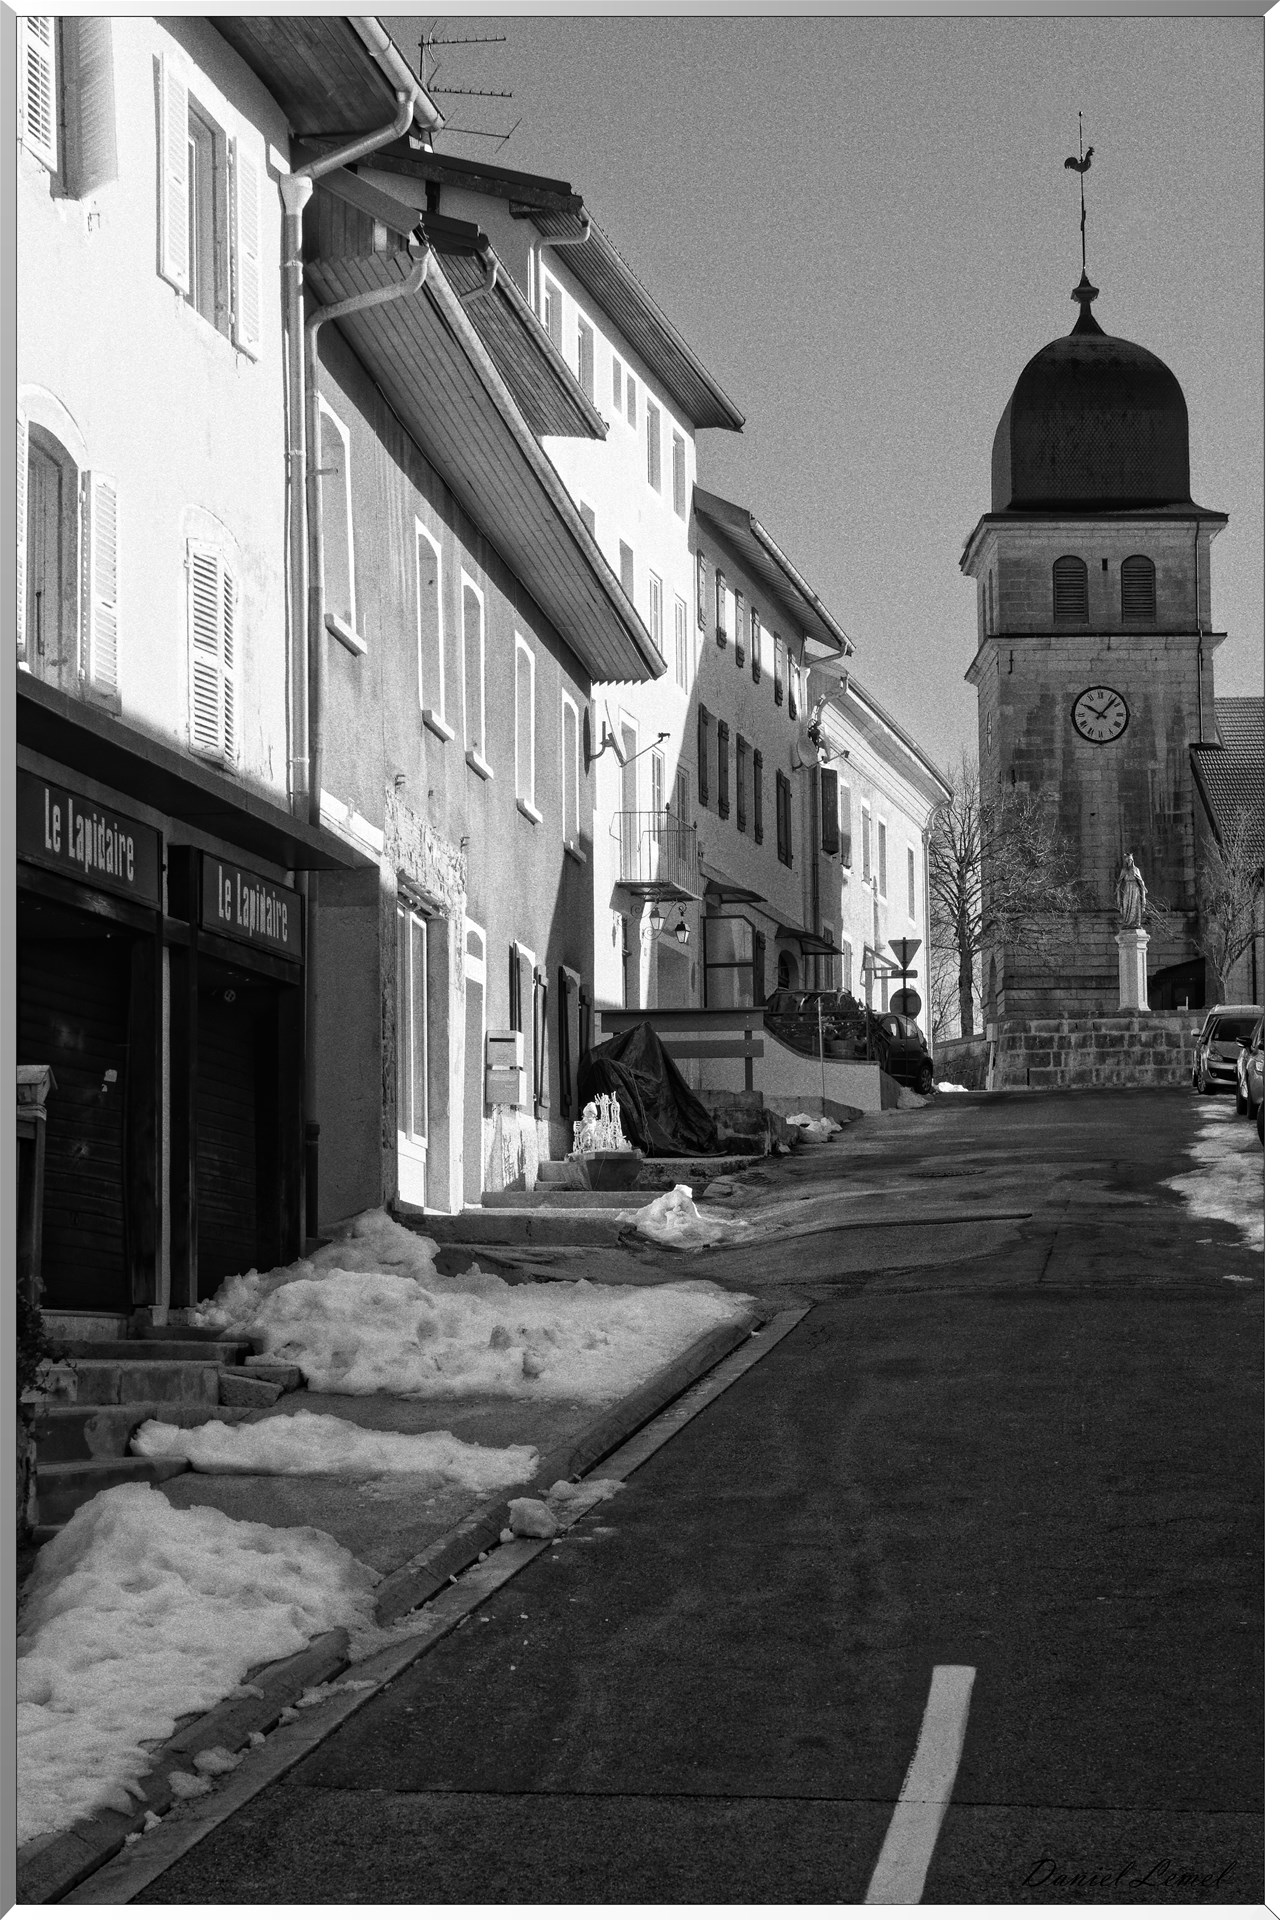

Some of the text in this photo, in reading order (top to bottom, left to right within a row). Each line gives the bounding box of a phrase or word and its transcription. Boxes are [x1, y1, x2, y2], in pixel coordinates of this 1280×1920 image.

[44, 788, 134, 882] Le Lapidaire
[218, 865, 288, 942] Le Lapidaire
